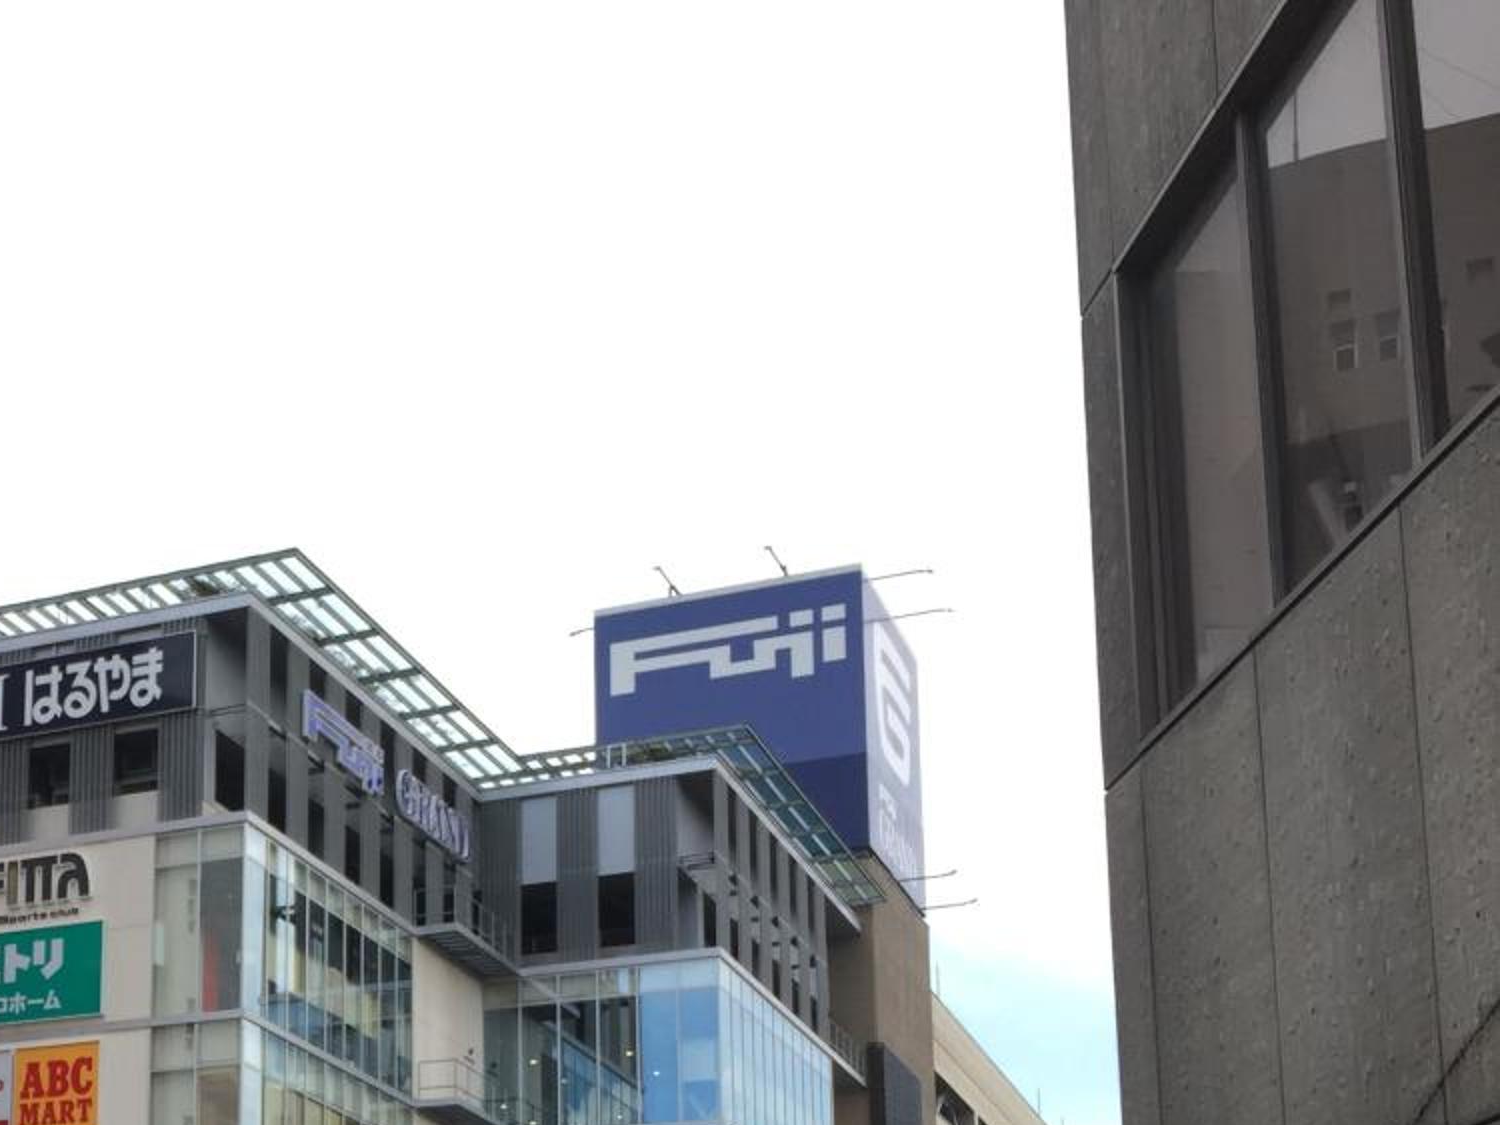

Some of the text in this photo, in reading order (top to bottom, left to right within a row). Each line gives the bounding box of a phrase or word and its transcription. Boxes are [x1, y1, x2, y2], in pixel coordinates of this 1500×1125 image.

[23, 647, 163, 727] はるやま
[20, 1057, 93, 1099] ABC
